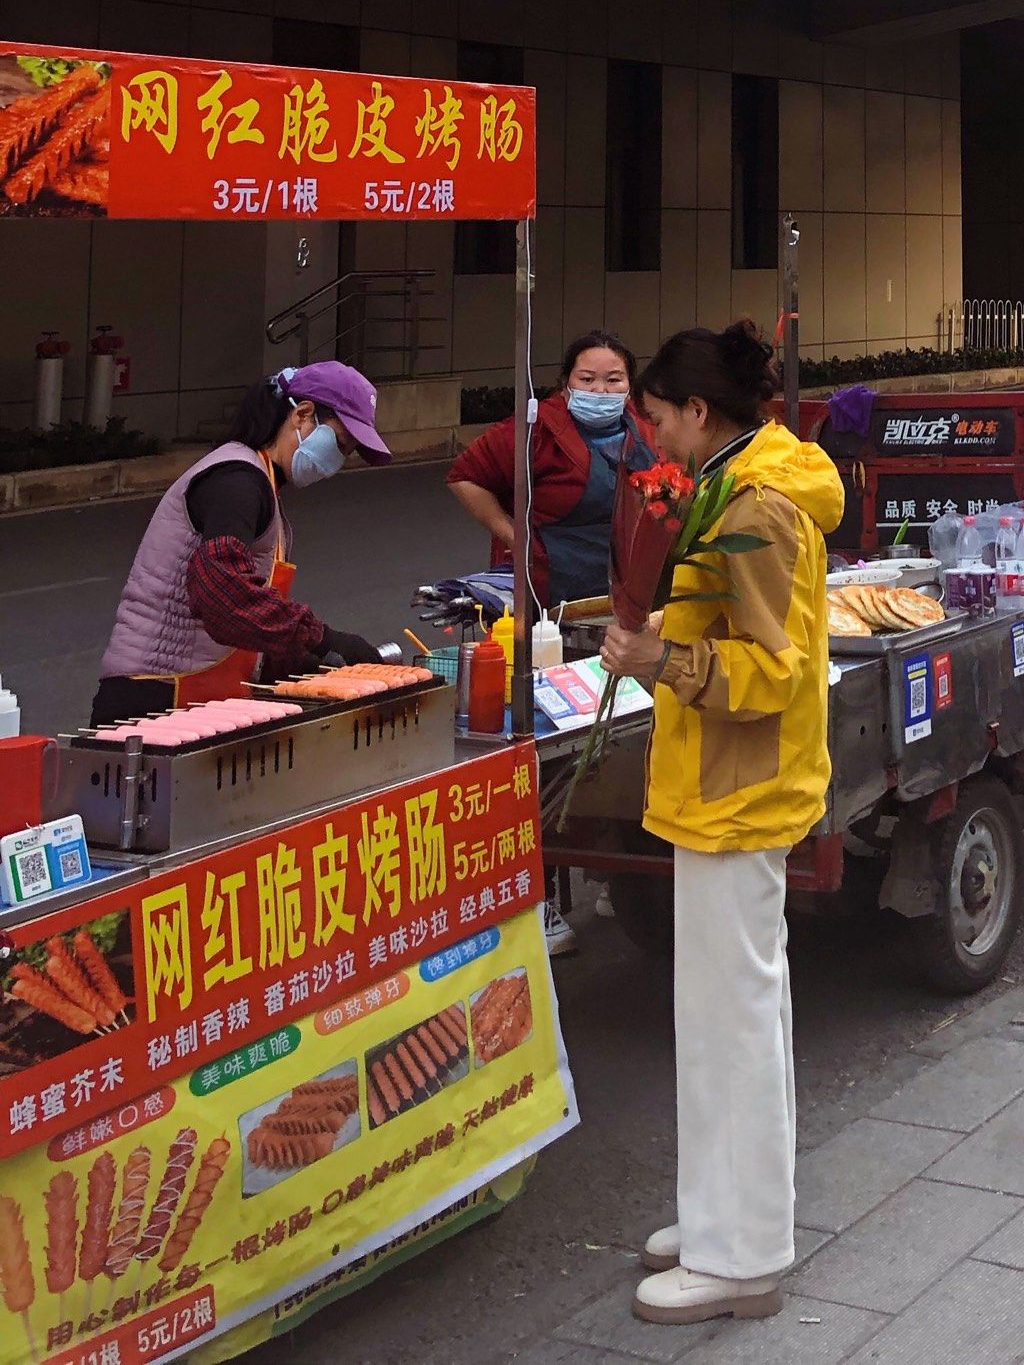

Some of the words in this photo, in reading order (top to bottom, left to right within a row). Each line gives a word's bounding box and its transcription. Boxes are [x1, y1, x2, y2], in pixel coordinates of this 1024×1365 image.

[120, 70, 522, 171] 网红脆皮烤肠
[213, 177, 319, 213] 3元/1根
[364, 179, 455, 212] 5元/2根
[955, 420, 999, 435] 电动车
[885, 500, 917, 518] 品质
[926, 499, 959, 518] 安全
[448, 763, 532, 823] 3元/一根
[453, 818, 536, 880] 5元/两根
[141, 787, 448, 1024] 网红脆皮烤肠
[9, 1056, 125, 1135] 蜂蜜芥末
[146, 997, 250, 1071] 秘制香辣
[264, 949, 357, 1017] 番茄沙拉
[368, 906, 449, 969] 美味沙拉
[459, 868, 532, 924] 经典五香
[201, 1031, 292, 1089] 美味爽脆
[61, 1090, 165, 1156] 鲜嫩口感
[138, 1295, 213, 1353] 5元/2根
